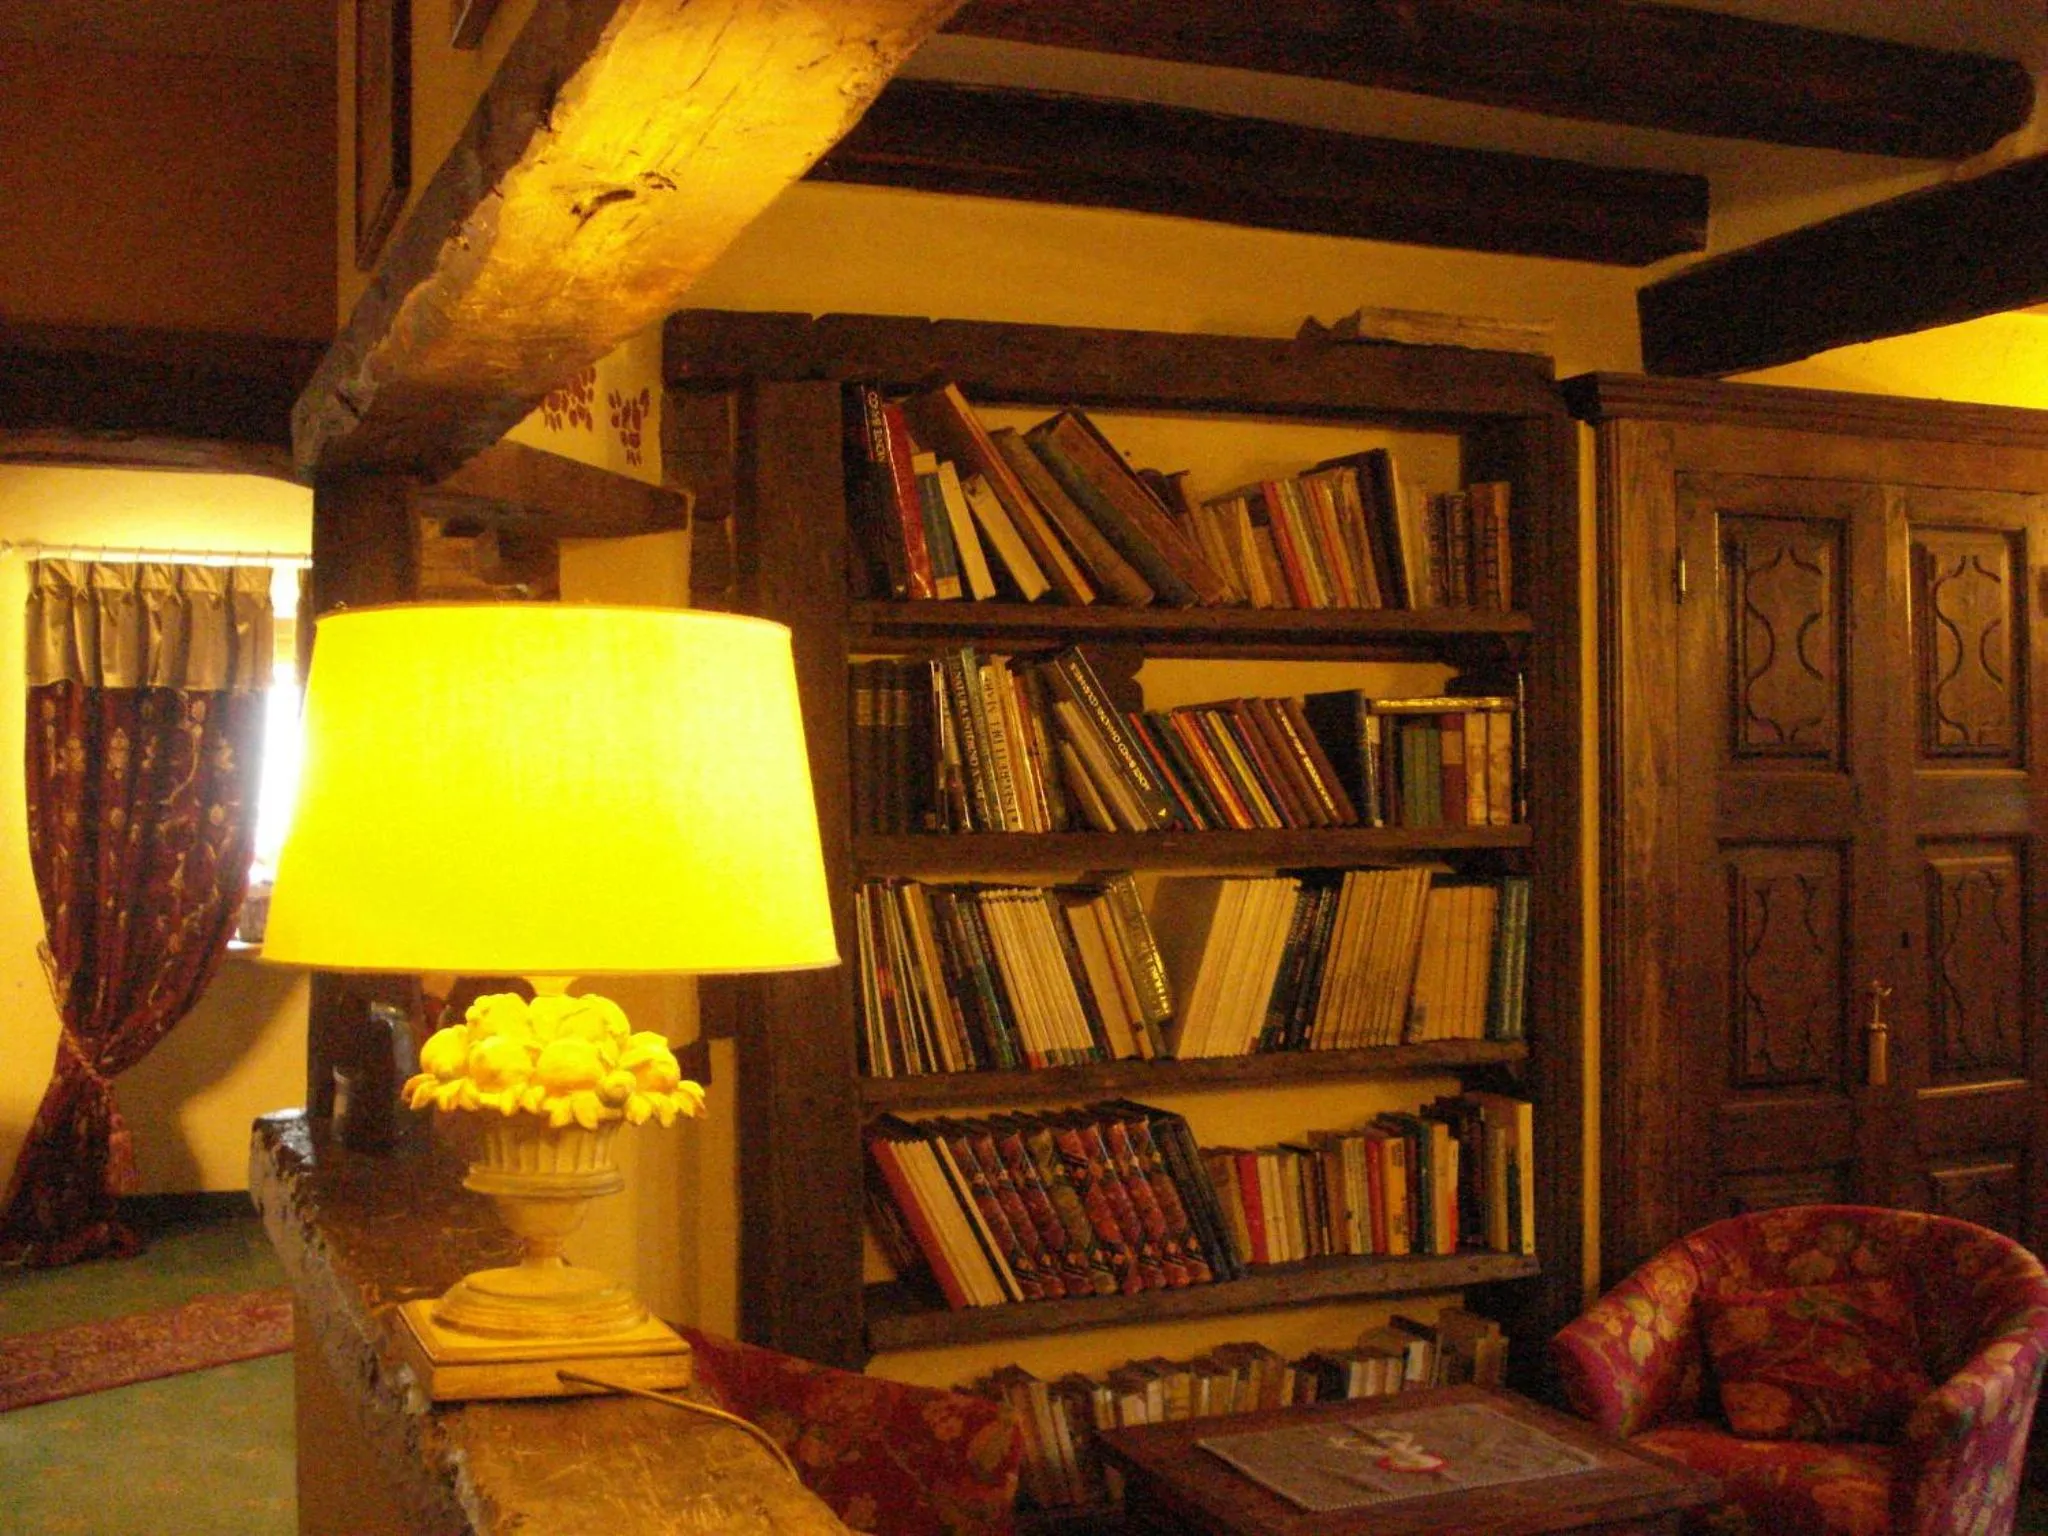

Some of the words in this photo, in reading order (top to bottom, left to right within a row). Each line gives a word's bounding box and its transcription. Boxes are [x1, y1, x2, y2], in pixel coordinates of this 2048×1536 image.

[983, 675, 999, 713] MARE
[989, 719, 1004, 743] DEL
[995, 748, 1015, 804] SEGRETI
